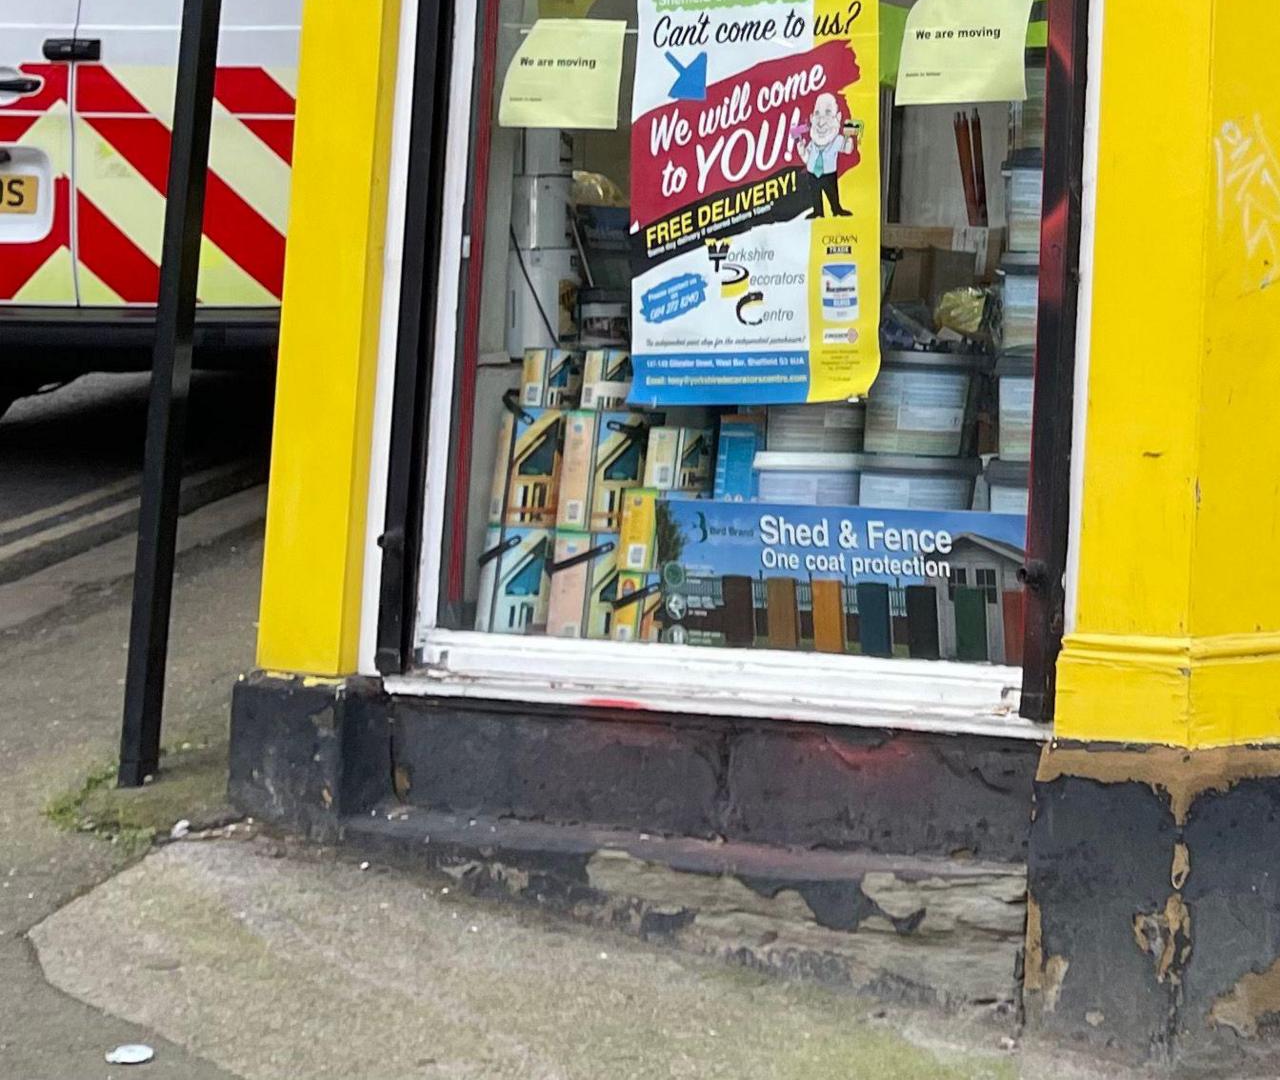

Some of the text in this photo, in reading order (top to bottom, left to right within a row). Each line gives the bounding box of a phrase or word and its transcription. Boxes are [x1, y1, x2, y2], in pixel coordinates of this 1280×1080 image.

[653, 0, 862, 49] Can't come to us?
[915, 27, 1001, 40] We are moving
[520, 57, 596, 69] We are moving
[650, 63, 827, 157] We will come
[0, 178, 24, 207] S
[661, 160, 688, 198] to
[645, 171, 798, 249] FREE DELIVERY!
[821, 234, 858, 245] CROWN
[760, 514, 953, 555] Shed & Fence
[761, 547, 951, 579] One coat protection
